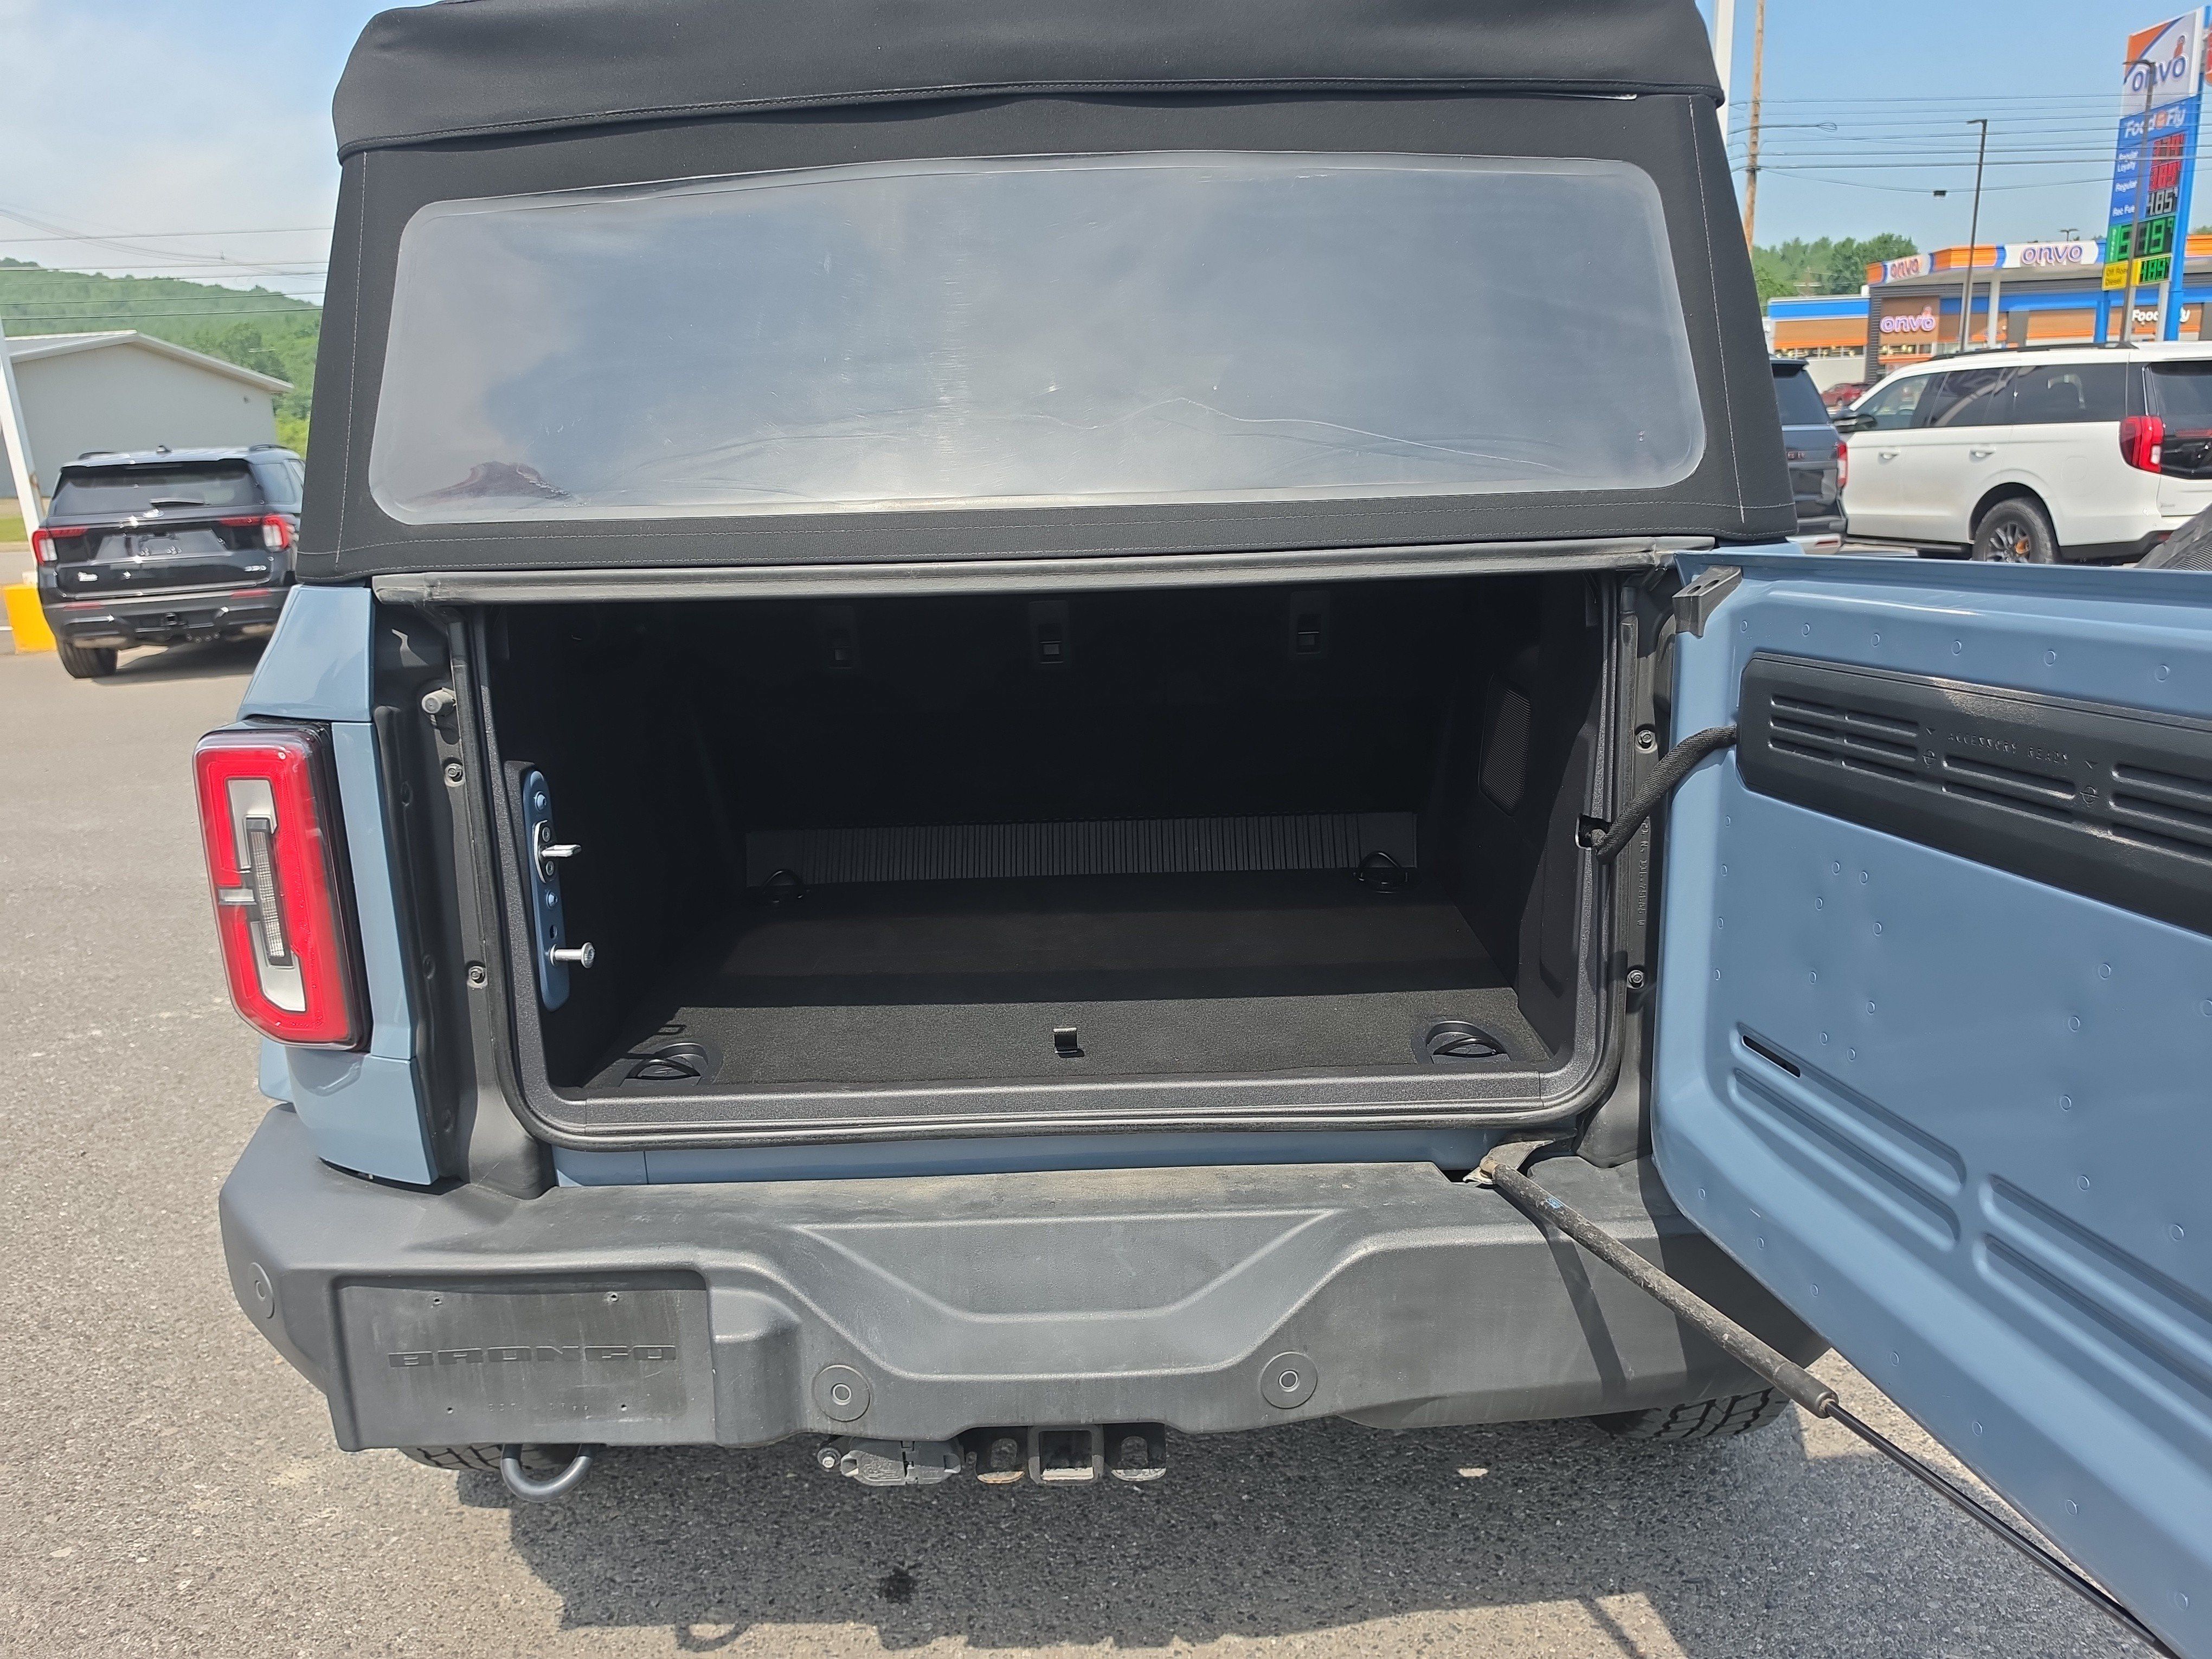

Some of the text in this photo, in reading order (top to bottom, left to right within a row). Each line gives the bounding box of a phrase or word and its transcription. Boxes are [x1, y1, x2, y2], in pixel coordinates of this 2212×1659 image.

[2022, 245, 2084, 265] onvo
[1890, 258, 1920, 279] onvo
[1880, 314, 1937, 333] onvo
[1948, 732, 2069, 767] ACCESSORY READY
[388, 1345, 677, 1368] BRONCO
